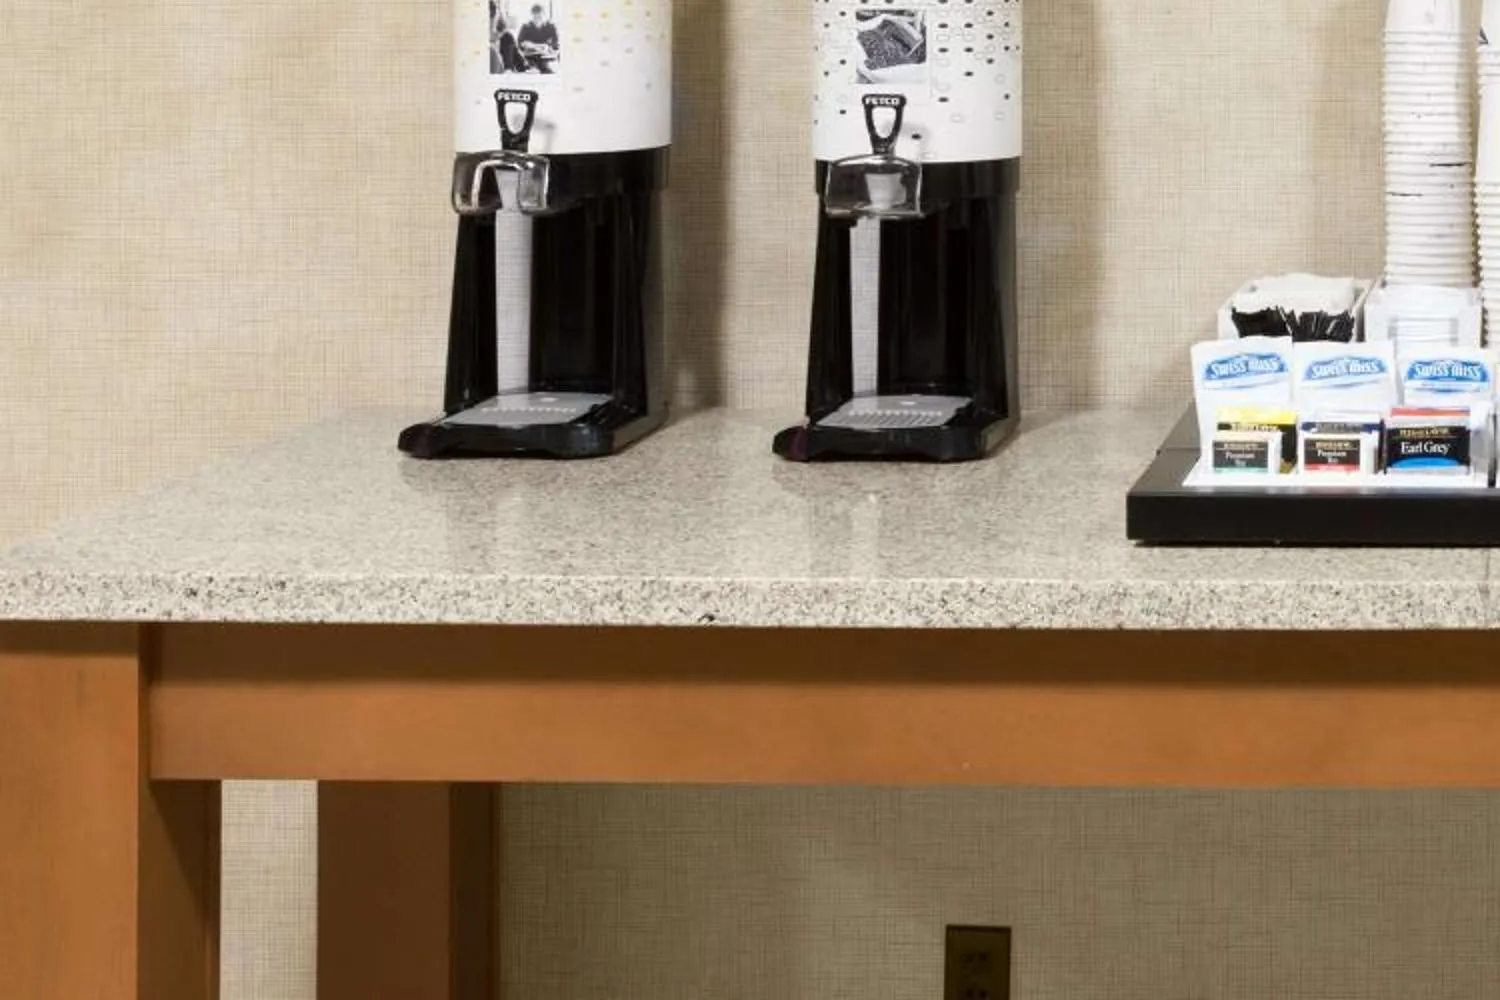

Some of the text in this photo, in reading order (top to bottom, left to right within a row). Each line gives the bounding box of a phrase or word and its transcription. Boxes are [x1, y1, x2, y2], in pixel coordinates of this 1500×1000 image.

[498, 91, 531, 101] FETCO
[865, 97, 900, 106] FETCO
[1414, 361, 1482, 378] Swiss Miss
[1400, 440, 1448, 455] Earl Grey
